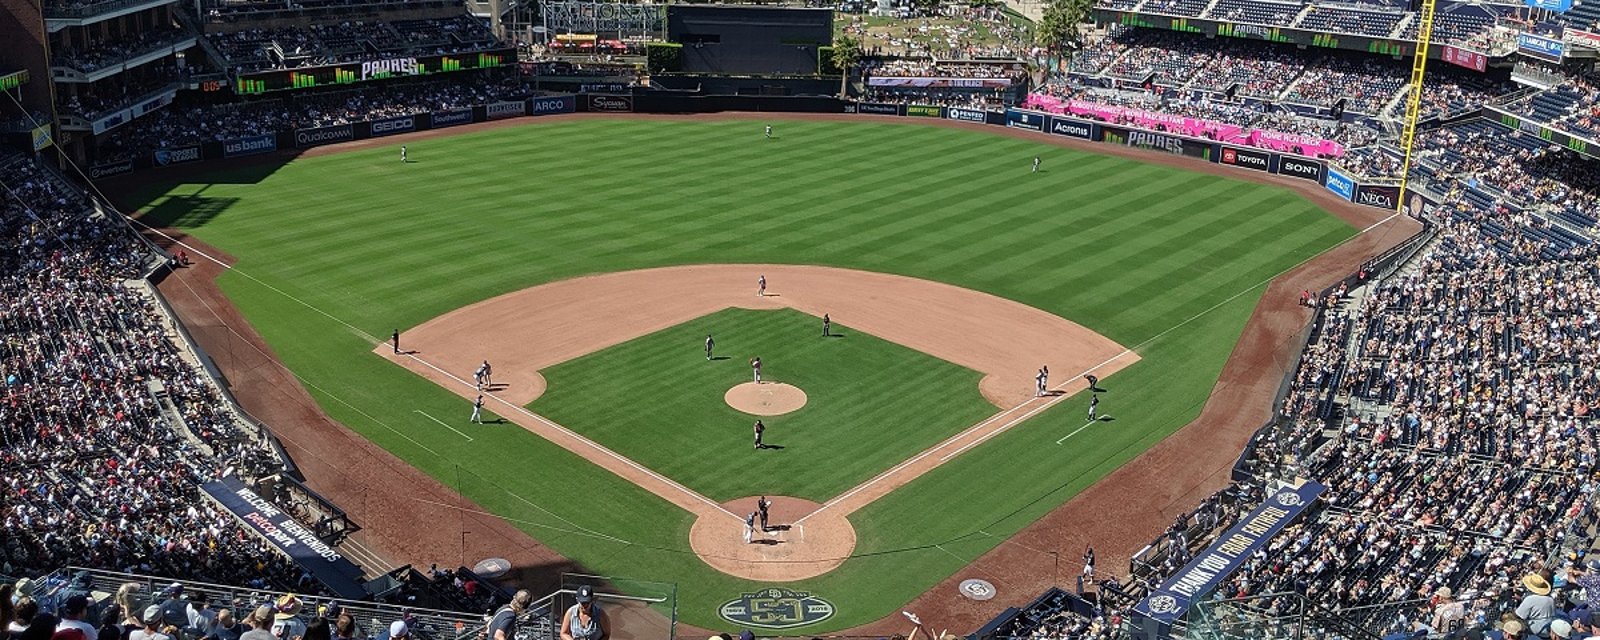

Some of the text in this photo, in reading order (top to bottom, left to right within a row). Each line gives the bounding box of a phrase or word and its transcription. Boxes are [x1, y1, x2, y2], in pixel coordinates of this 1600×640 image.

[1234, 24, 1269, 37] PADRES
[362, 57, 419, 80] PADRES
[535, 100, 564, 111] ARCO
[434, 112, 466, 124] Southwest
[960, 110, 983, 118] PENFED
[372, 118, 413, 132] GEICO
[1055, 121, 1088, 136] Acronis
[298, 128, 351, 143] Qualcomm
[1127, 131, 1184, 154] PADRES
[1261, 131, 1321, 147] HOME RUN DECK
[1237, 154, 1266, 166] TOYOTA
[1285, 162, 1319, 176] SONY
[1360, 191, 1392, 207] NECA
[236, 487, 342, 563] WELCOME BIENVENIDOS
[1169, 506, 1290, 597] THANK YOU FRIAR FAITHFUL
